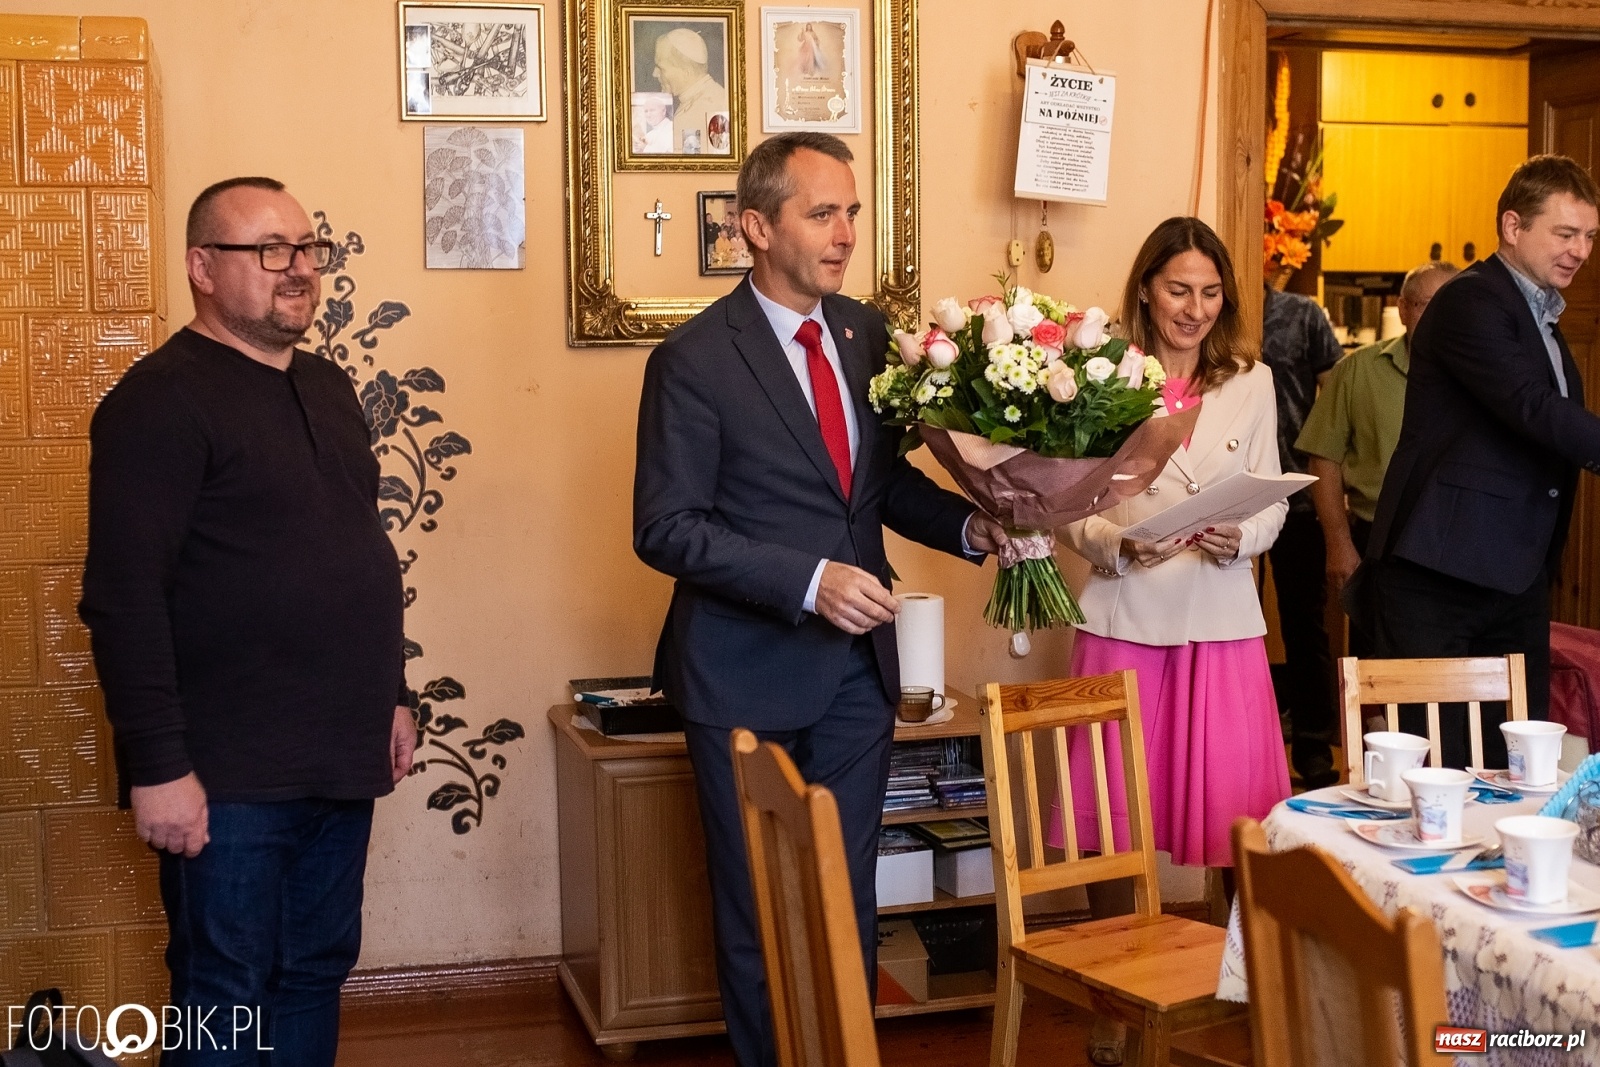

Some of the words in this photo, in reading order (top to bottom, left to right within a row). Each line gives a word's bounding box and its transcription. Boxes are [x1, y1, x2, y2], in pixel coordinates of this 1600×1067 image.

[1050, 74, 1093, 91] ŻYCIE
[1039, 108, 1053, 118] NA
[1056, 108, 1099, 124] PÓŹNIEJ
